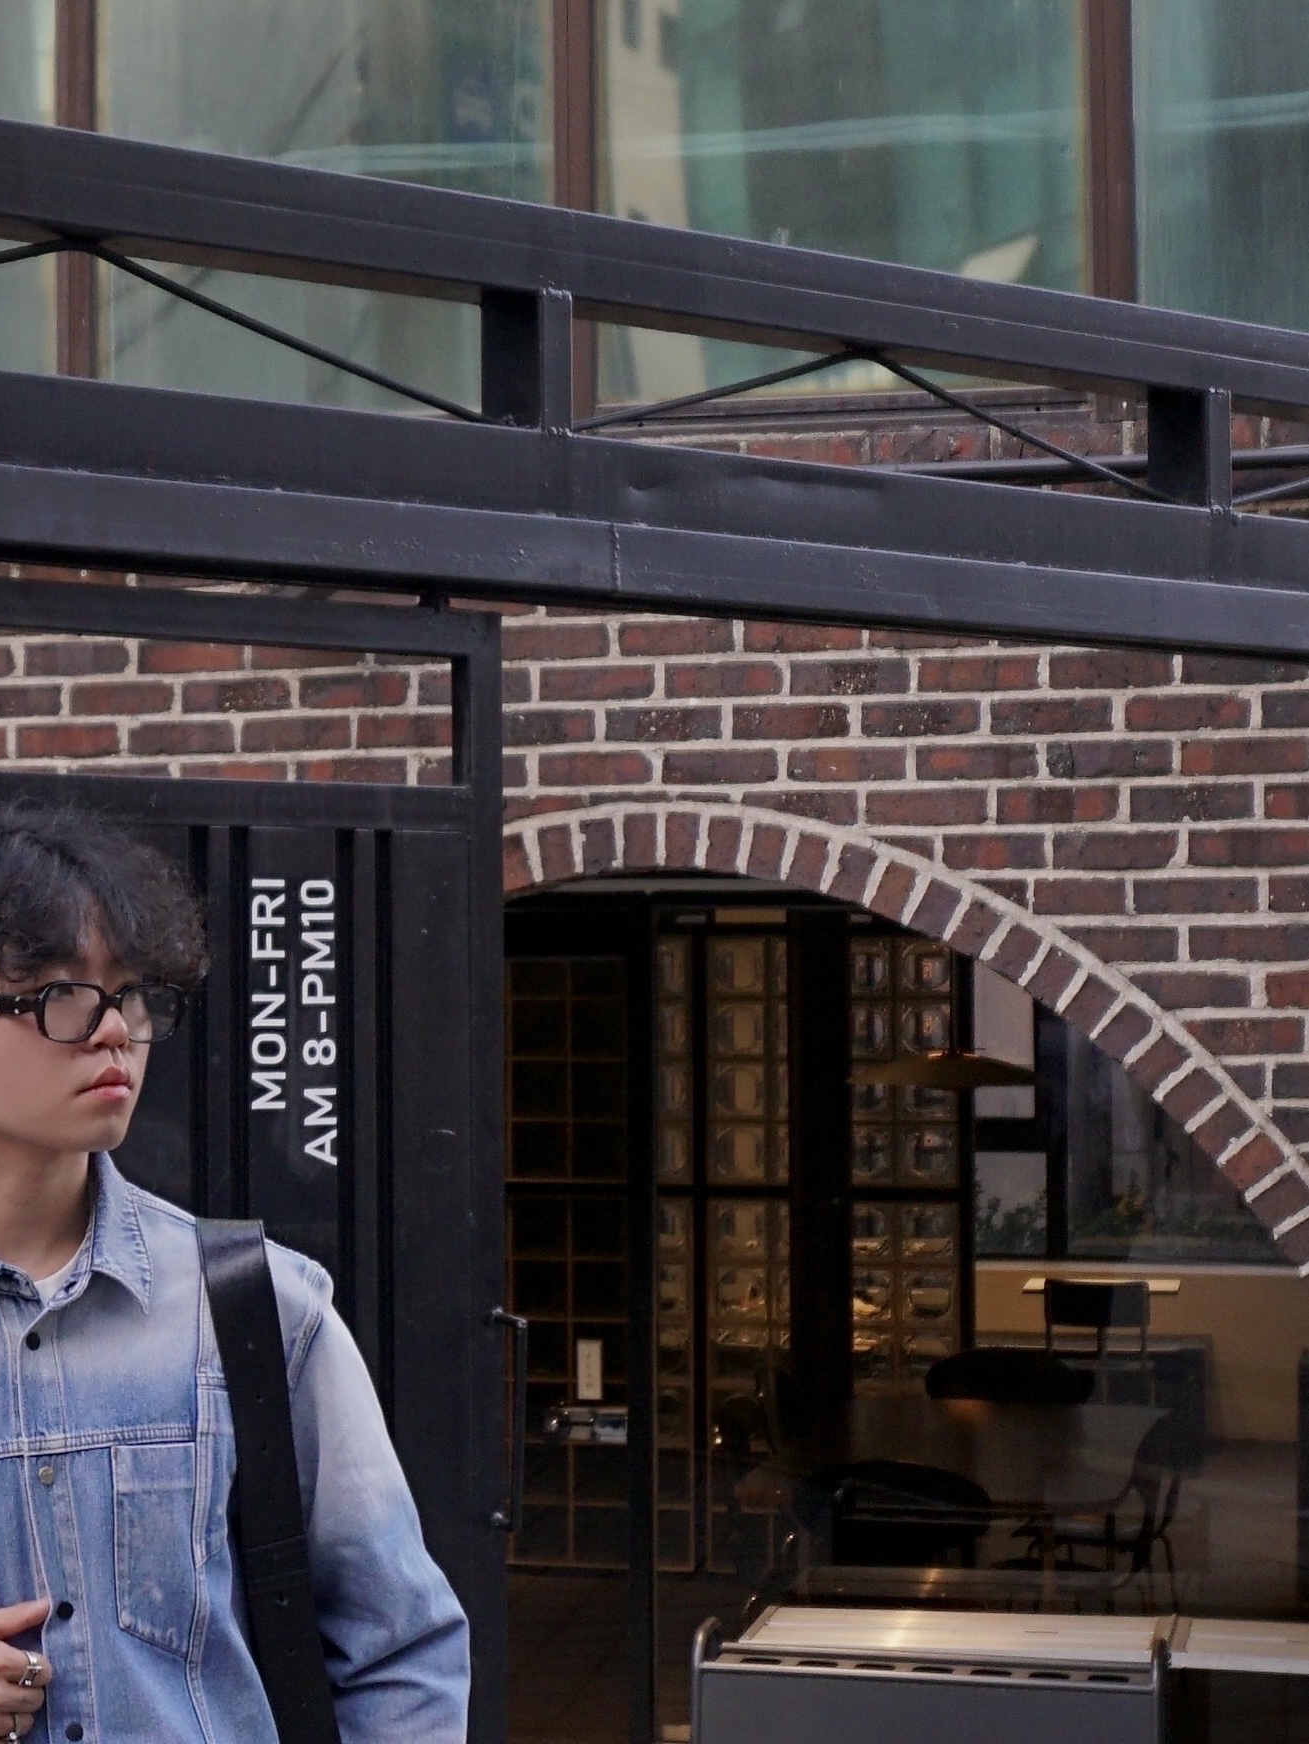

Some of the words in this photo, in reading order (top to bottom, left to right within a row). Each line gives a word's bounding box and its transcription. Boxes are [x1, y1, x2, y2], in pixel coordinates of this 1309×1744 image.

[251, 878, 287, 1110] MON-FRI
[300, 879, 337, 1066] 8-PM10
[303, 1087, 338, 1166] AM
